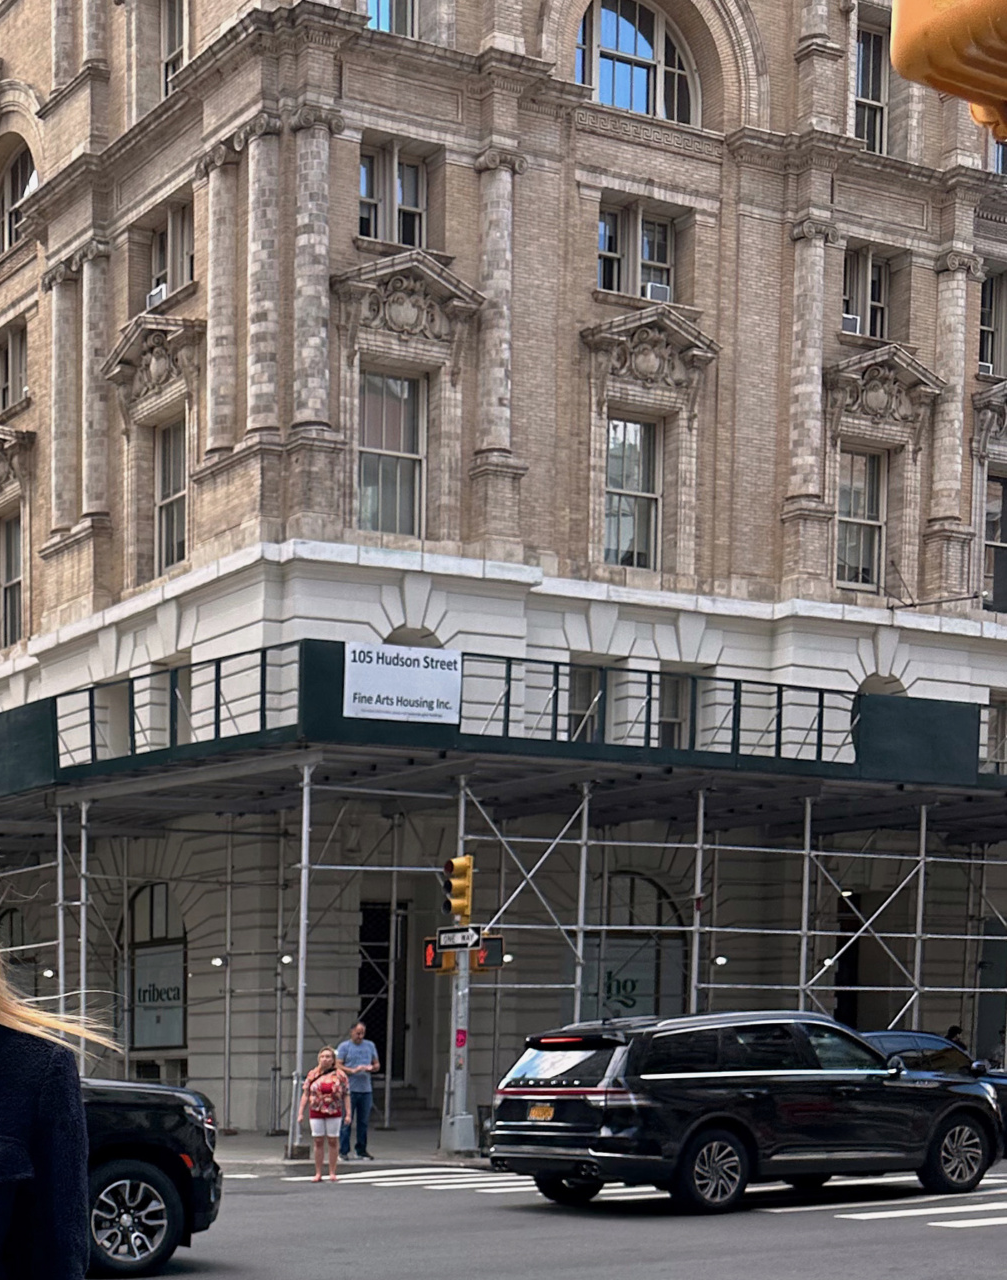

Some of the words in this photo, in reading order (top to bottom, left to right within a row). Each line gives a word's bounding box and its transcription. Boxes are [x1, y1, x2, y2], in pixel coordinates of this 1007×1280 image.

[351, 650, 373, 664] 105
[376, 652, 420, 668] Hudson
[423, 656, 458, 671] Street
[353, 692, 373, 705] Fine
[374, 694, 394, 706] Arts
[396, 696, 435, 711] Housing
[436, 699, 452, 710] Inc.
[138, 984, 180, 1003] tribeca
